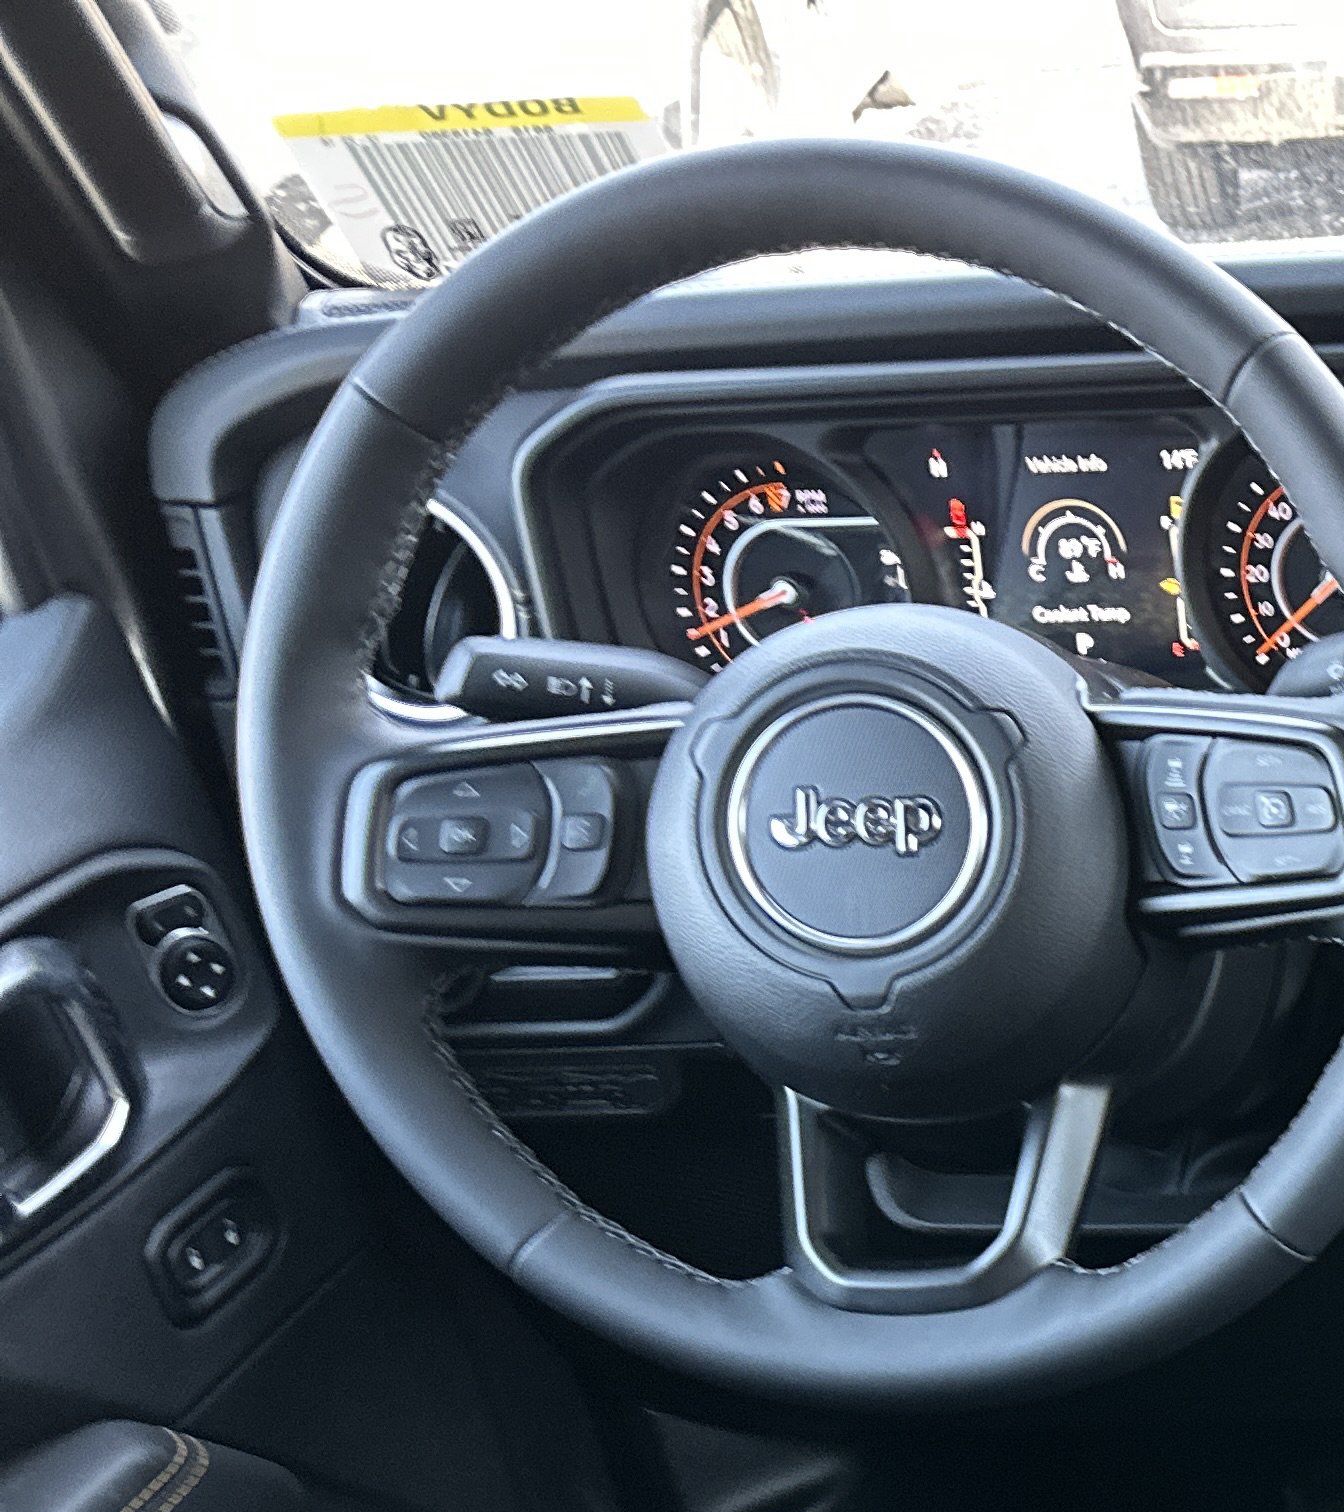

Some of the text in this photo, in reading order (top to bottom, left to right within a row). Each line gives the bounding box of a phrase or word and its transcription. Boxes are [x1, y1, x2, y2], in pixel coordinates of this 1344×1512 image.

[1025, 453, 1108, 473] Vehicle Info
[1028, 563, 1047, 583] C
[1108, 561, 1125, 579] H
[1076, 632, 1095, 655] P
[769, 785, 942, 857] Jeep
